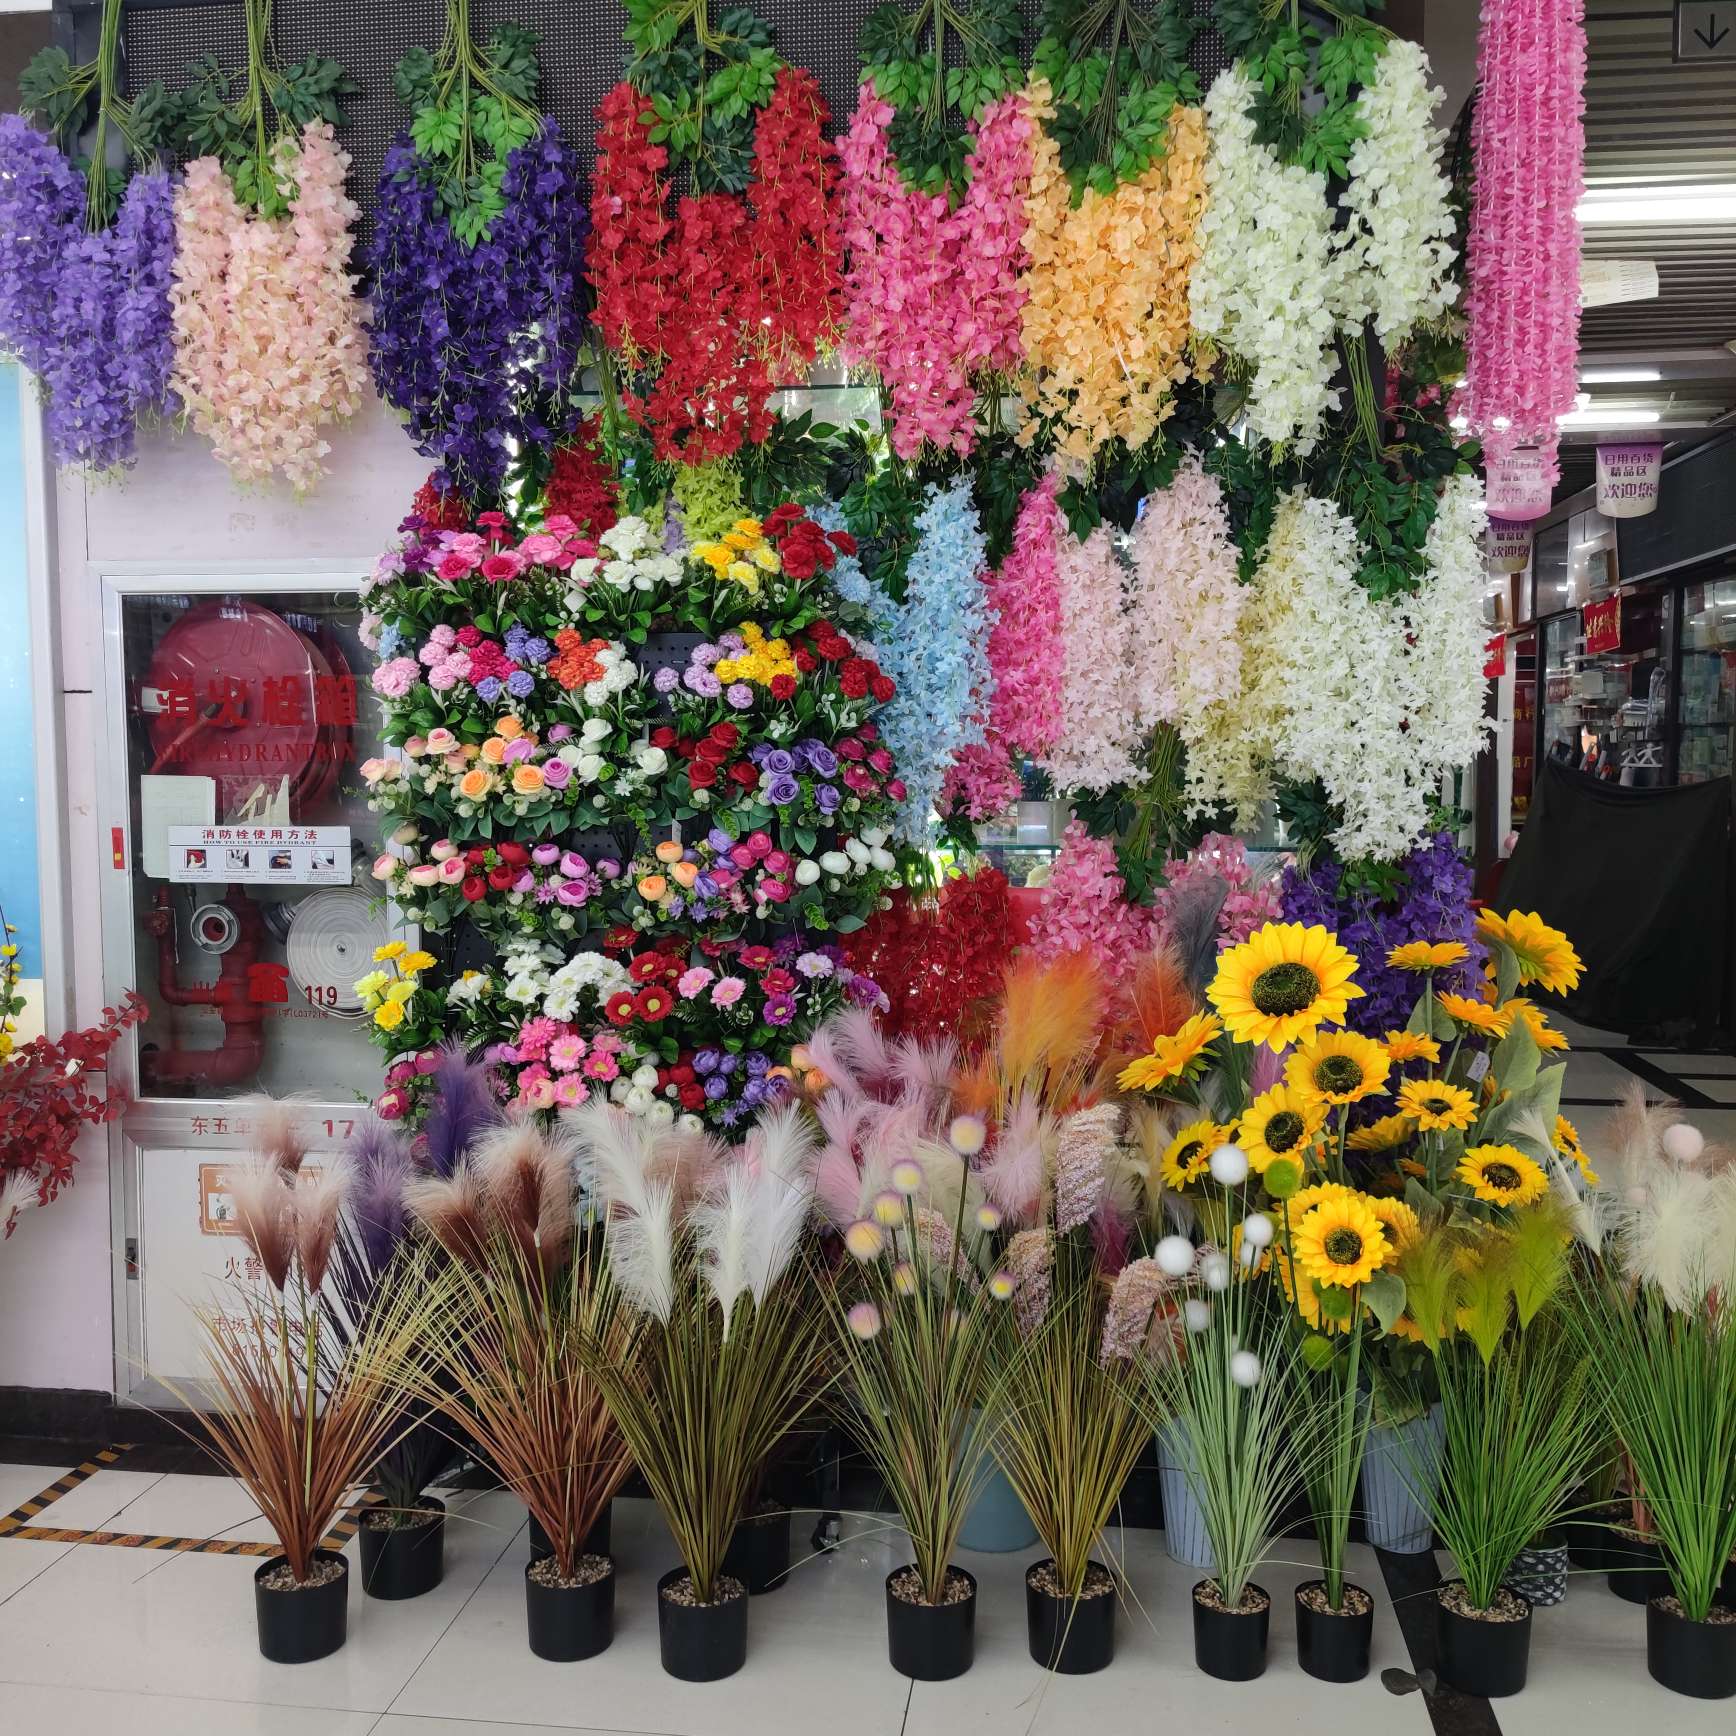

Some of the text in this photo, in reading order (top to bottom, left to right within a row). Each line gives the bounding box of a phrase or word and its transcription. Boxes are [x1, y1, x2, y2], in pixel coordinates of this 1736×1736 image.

[1604, 454, 1654, 466] 日用百货
[1610, 466, 1648, 477] 精品区
[1603, 482, 1656, 499] 欢迎您
[201, 829, 318, 840] 消防栓使用方法
[305, 985, 338, 1006] 119
